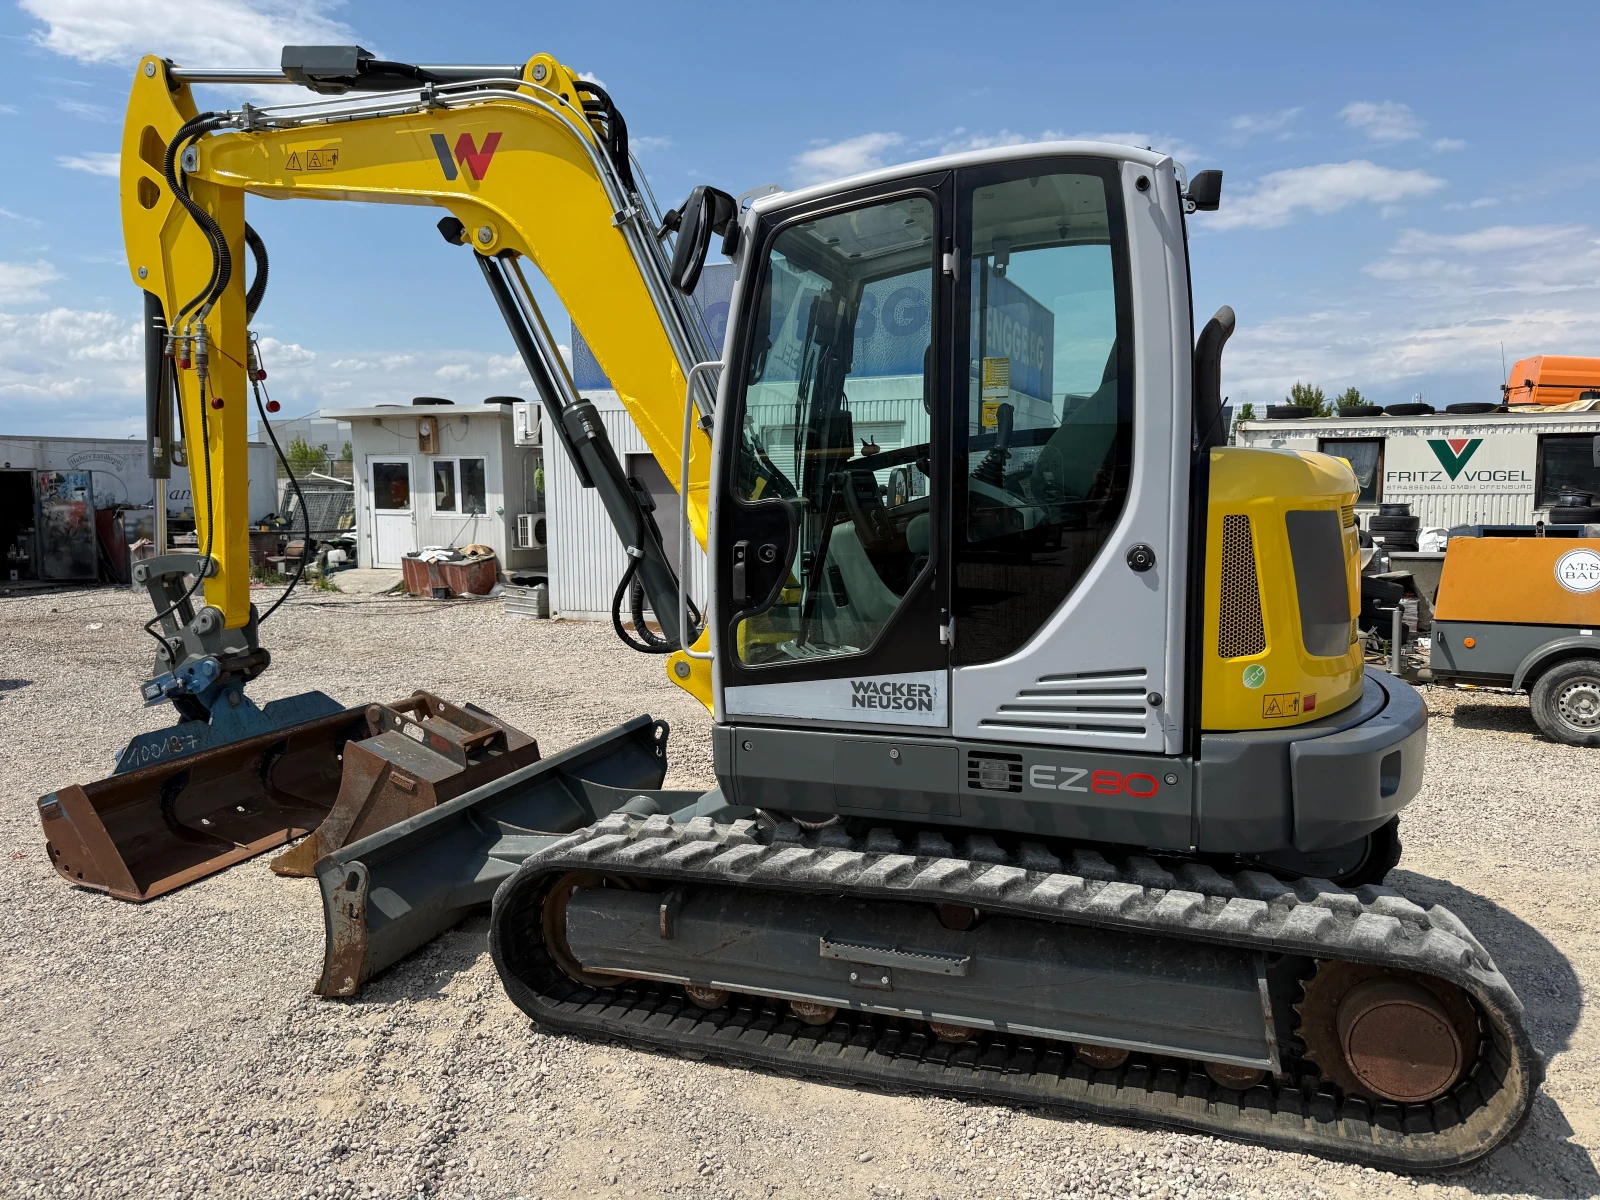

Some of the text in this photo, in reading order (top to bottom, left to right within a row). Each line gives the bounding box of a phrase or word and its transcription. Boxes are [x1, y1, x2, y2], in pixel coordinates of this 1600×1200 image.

[1386, 470, 1532, 482] FRITZ VOGEL
[1565, 571, 1600, 580] BAU
[1244, 666, 1265, 688] ECO
[850, 680, 932, 697] WACKER
[851, 694, 933, 712] NEUSON
[1029, 764, 1159, 798] EZ80
